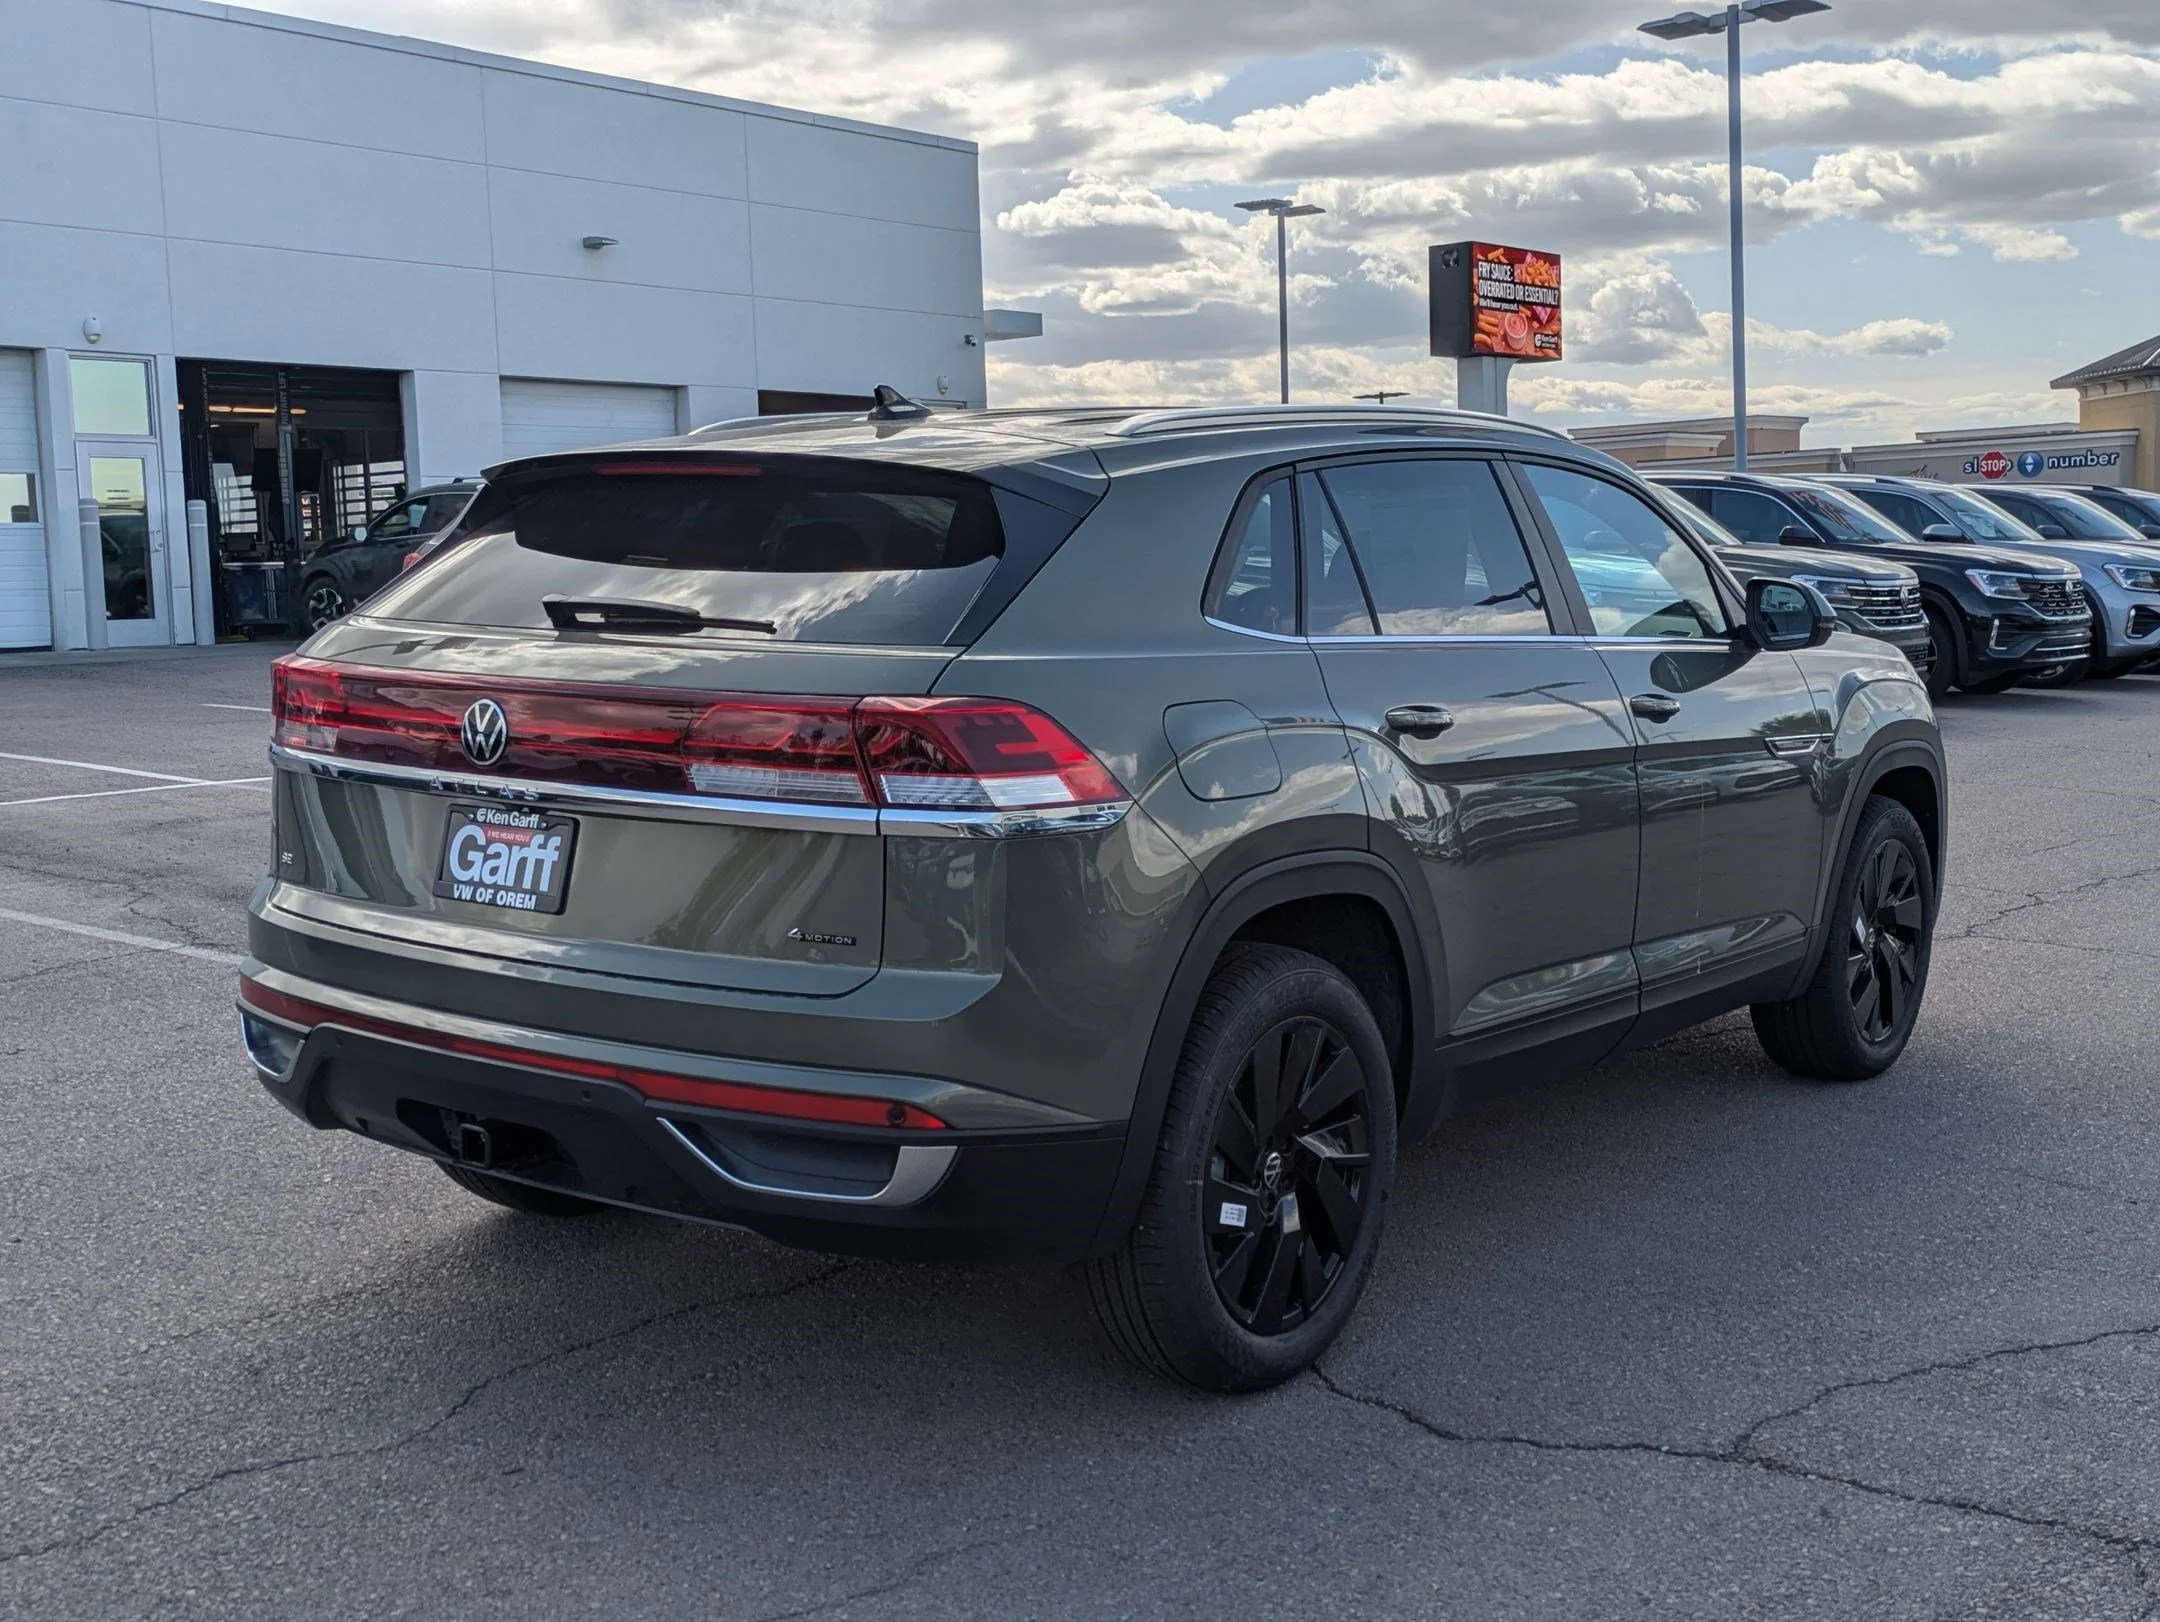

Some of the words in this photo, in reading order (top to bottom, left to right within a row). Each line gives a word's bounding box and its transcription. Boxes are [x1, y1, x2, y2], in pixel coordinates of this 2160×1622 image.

[1478, 261, 1491, 279] FRY
[1491, 263, 1513, 281] SAUCE:
[1479, 280, 1514, 300] OVERRATED
[1515, 285, 1524, 301] OR
[1525, 286, 1559, 305] ESSENTIAL?
[1981, 459, 2006, 472] STOP
[2048, 451, 2120, 469] number
[491, 830, 500, 839] WE
[500, 832, 515, 840] HEAR
[515, 834, 526, 842] YOU
[281, 851, 293, 865] SE
[449, 824, 561, 892] Garff
[453, 883, 474, 901] VW
[475, 887, 494, 903] OF
[496, 890, 537, 910] OREM
